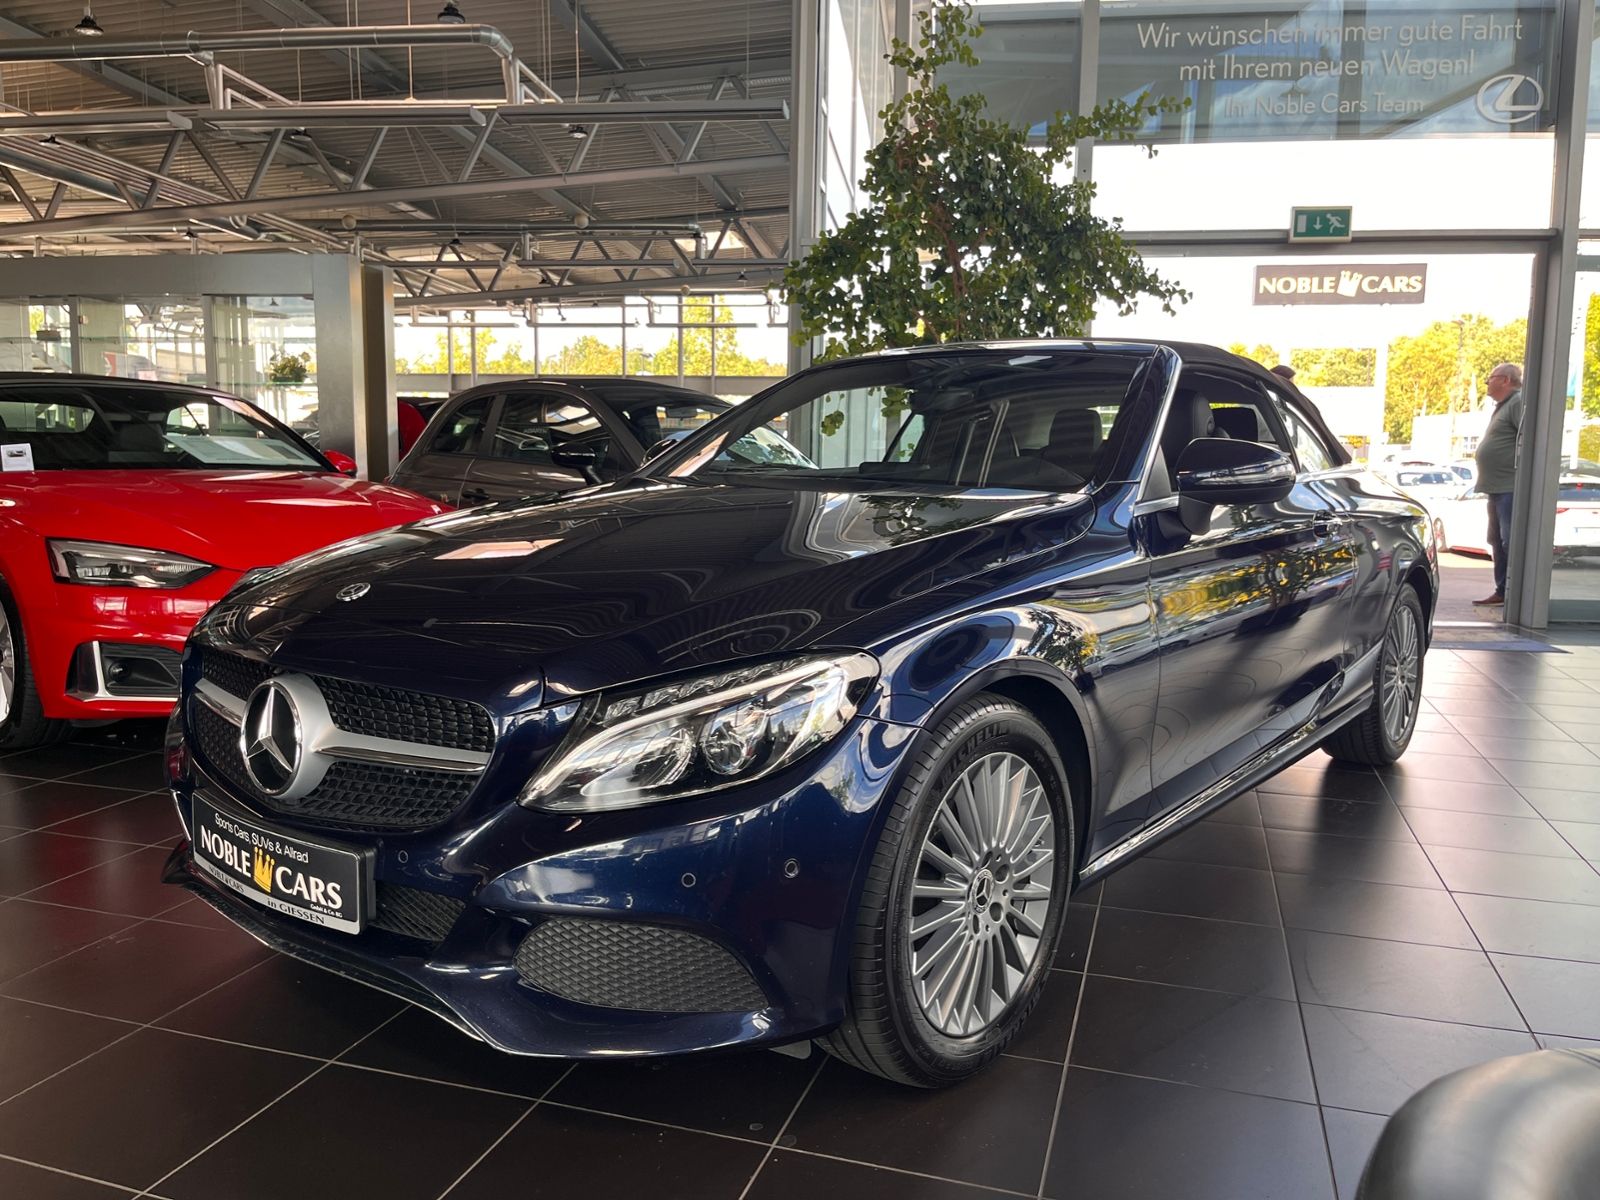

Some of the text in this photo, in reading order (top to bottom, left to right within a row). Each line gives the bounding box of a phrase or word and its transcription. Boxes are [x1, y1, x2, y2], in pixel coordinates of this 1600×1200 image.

[1137, 14, 1523, 48] Wir wünschen immer gute Fahrt
[1179, 48, 1475, 81] mit Ihrem neuen Wagen!
[1224, 91, 1424, 119] Ihr Noble Cars Team
[1258, 275, 1423, 294] NOBLE CARS
[214, 812, 234, 834] Sports
[251, 832, 275, 852] SUVs
[275, 841, 283, 855] &
[283, 844, 309, 864] Allrad
[200, 824, 343, 910] NOBLE CARS
[267, 896, 325, 925] in GIESSEN
